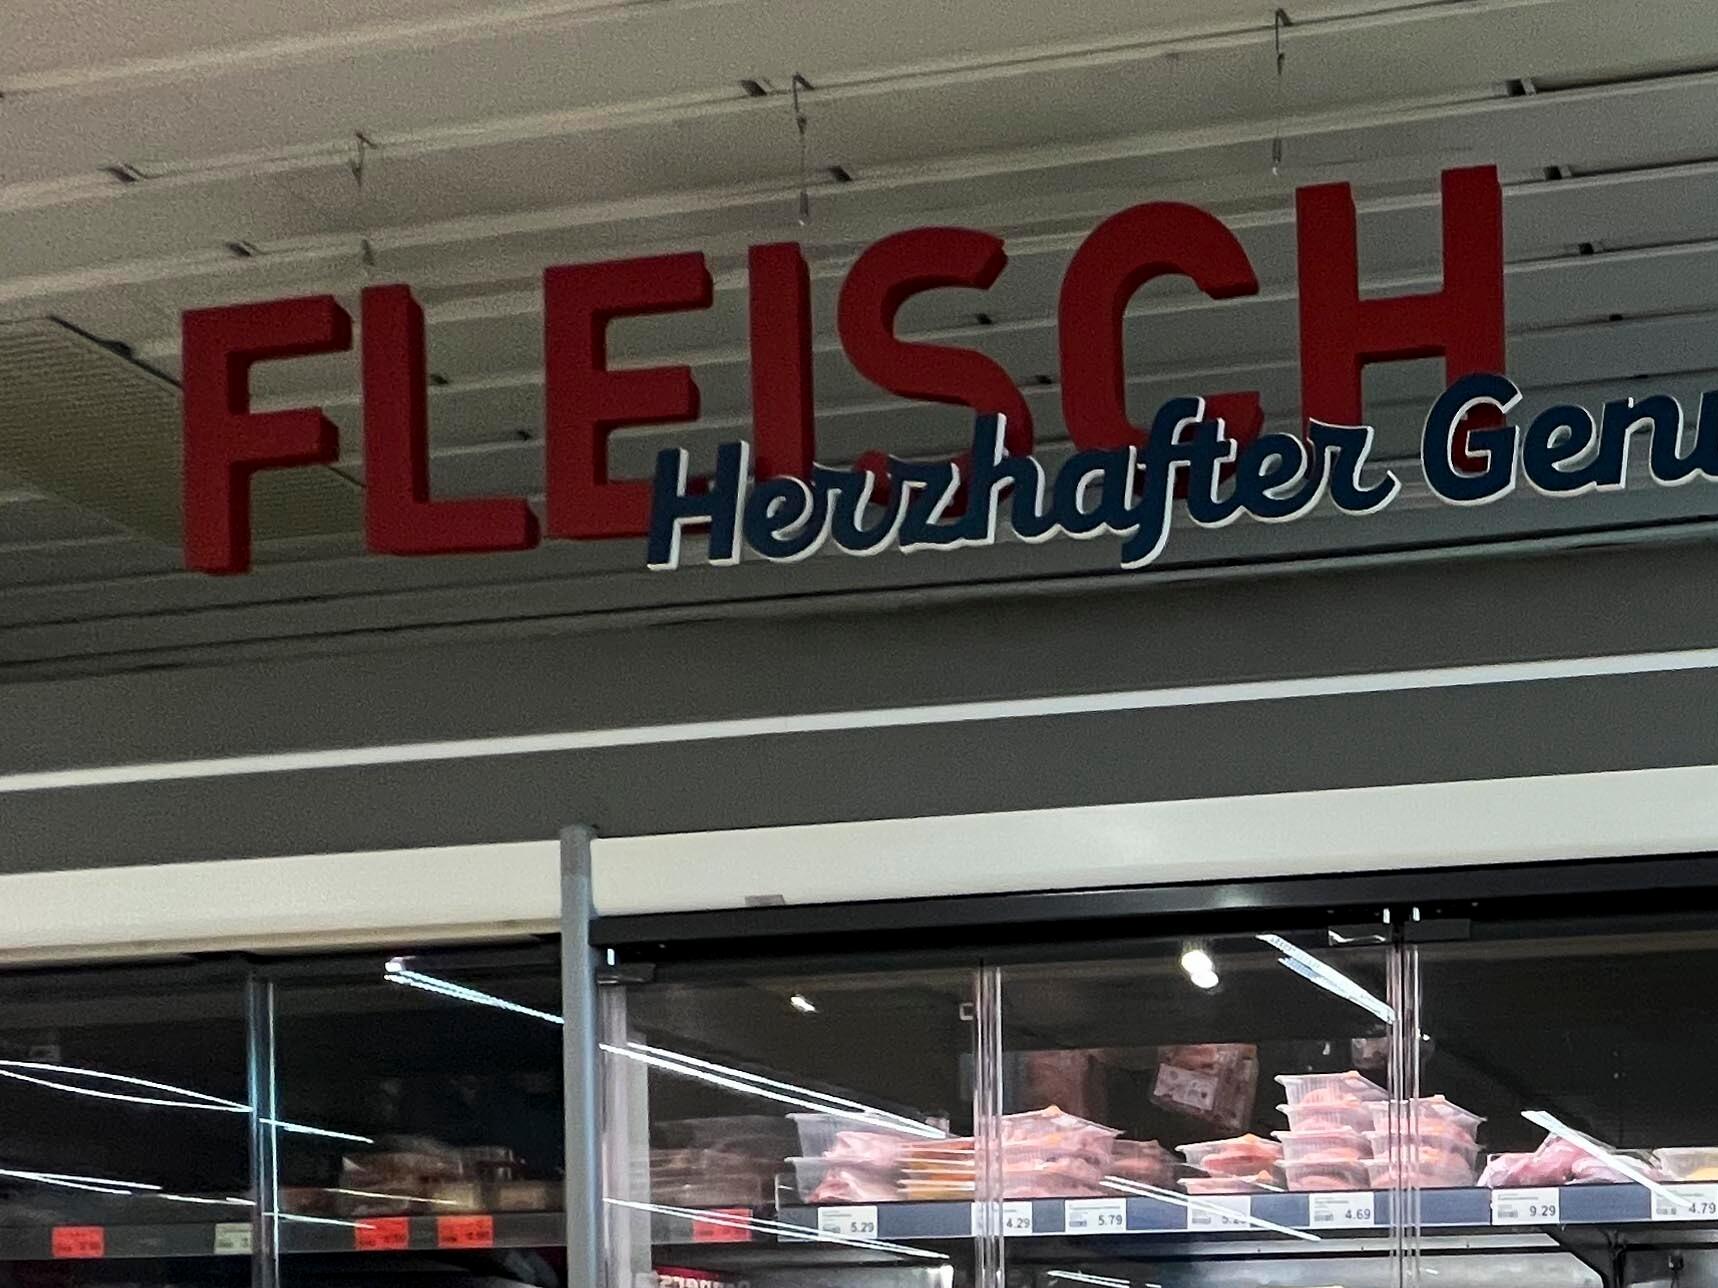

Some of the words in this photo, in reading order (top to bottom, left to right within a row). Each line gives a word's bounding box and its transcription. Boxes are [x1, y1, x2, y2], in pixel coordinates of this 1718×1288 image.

[181, 165, 1504, 574] FLEISCH
[647, 397, 1400, 569] Herzhafter
[1530, 1205, 1556, 1216] 9.29
[1689, 1202, 1716, 1214] 4.79
[1345, 1209, 1370, 1220] 4.69
[1007, 1218, 1030, 1229] 4.29
[1099, 1215, 1122, 1226] 5.79
[851, 1222, 874, 1233] 5.29
